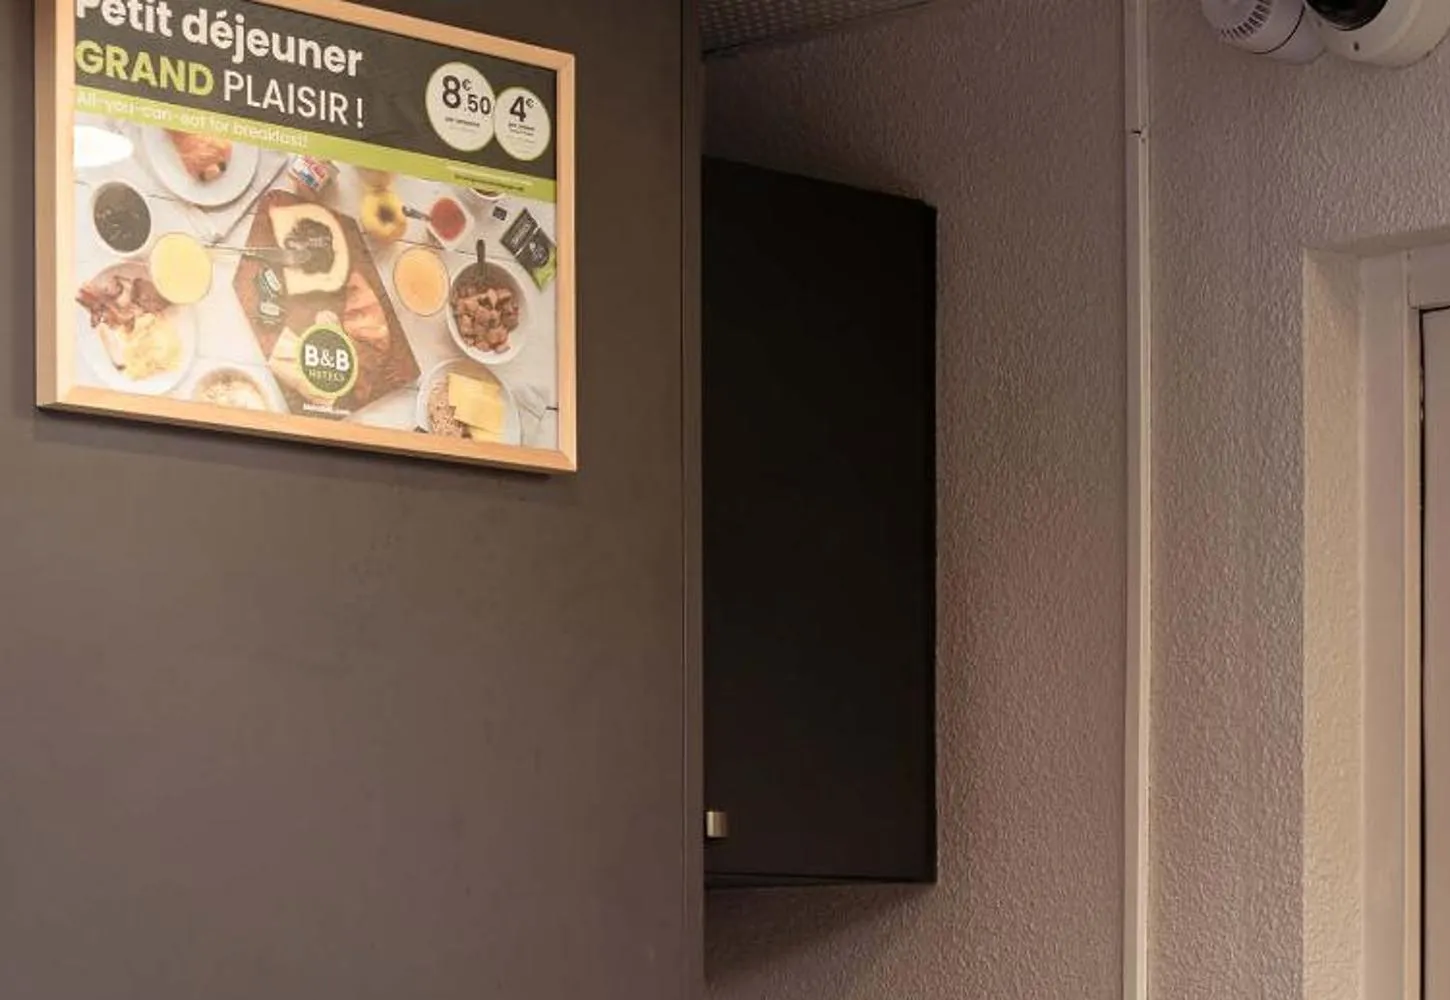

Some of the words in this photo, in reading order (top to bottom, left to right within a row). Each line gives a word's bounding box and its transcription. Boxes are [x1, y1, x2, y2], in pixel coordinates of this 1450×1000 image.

[181, 8, 363, 77] déjeuner
[75, 39, 215, 97] GRAND
[223, 69, 349, 126] PLAISIR
[305, 343, 350, 372] B&B
